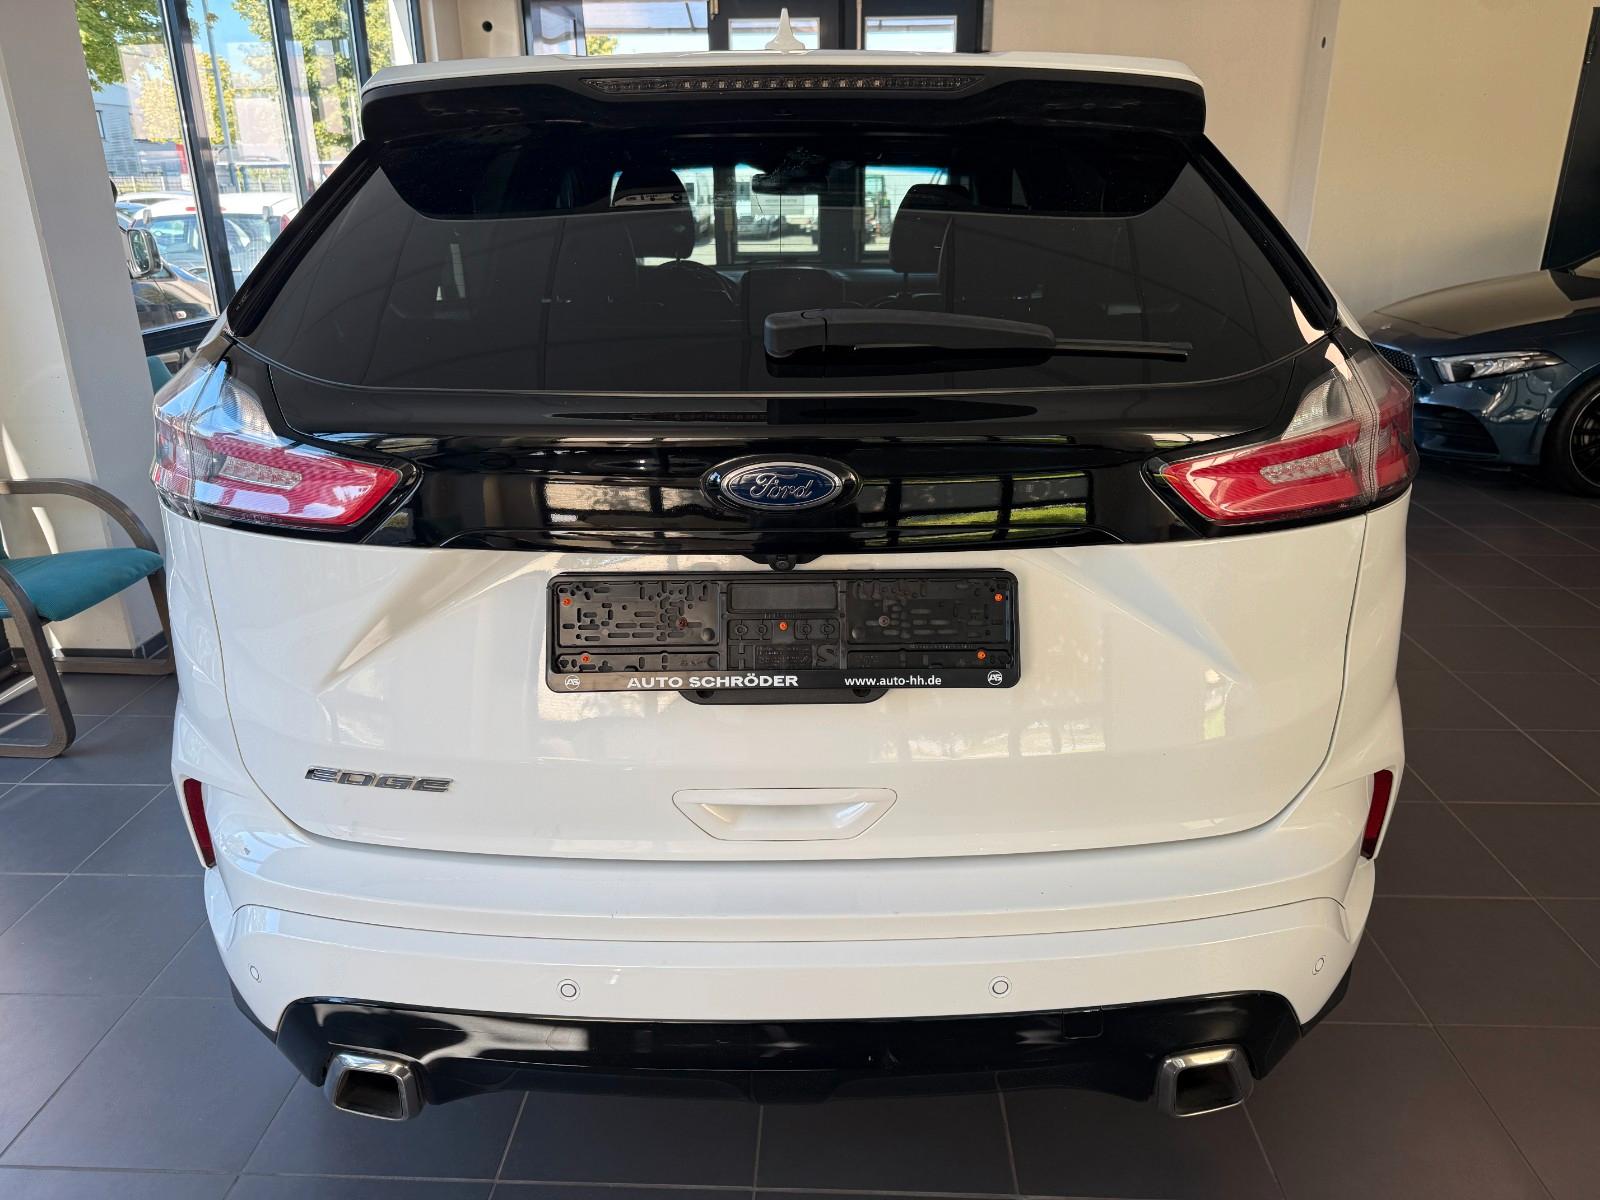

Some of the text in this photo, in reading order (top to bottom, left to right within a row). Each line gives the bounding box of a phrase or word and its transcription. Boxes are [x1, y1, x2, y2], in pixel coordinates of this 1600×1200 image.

[750, 472, 814, 498] Ford
[627, 673, 799, 689] AUTO SCHRÖDER
[844, 675, 942, 686] www.auto-hh.de
[304, 765, 453, 793] EDGE
